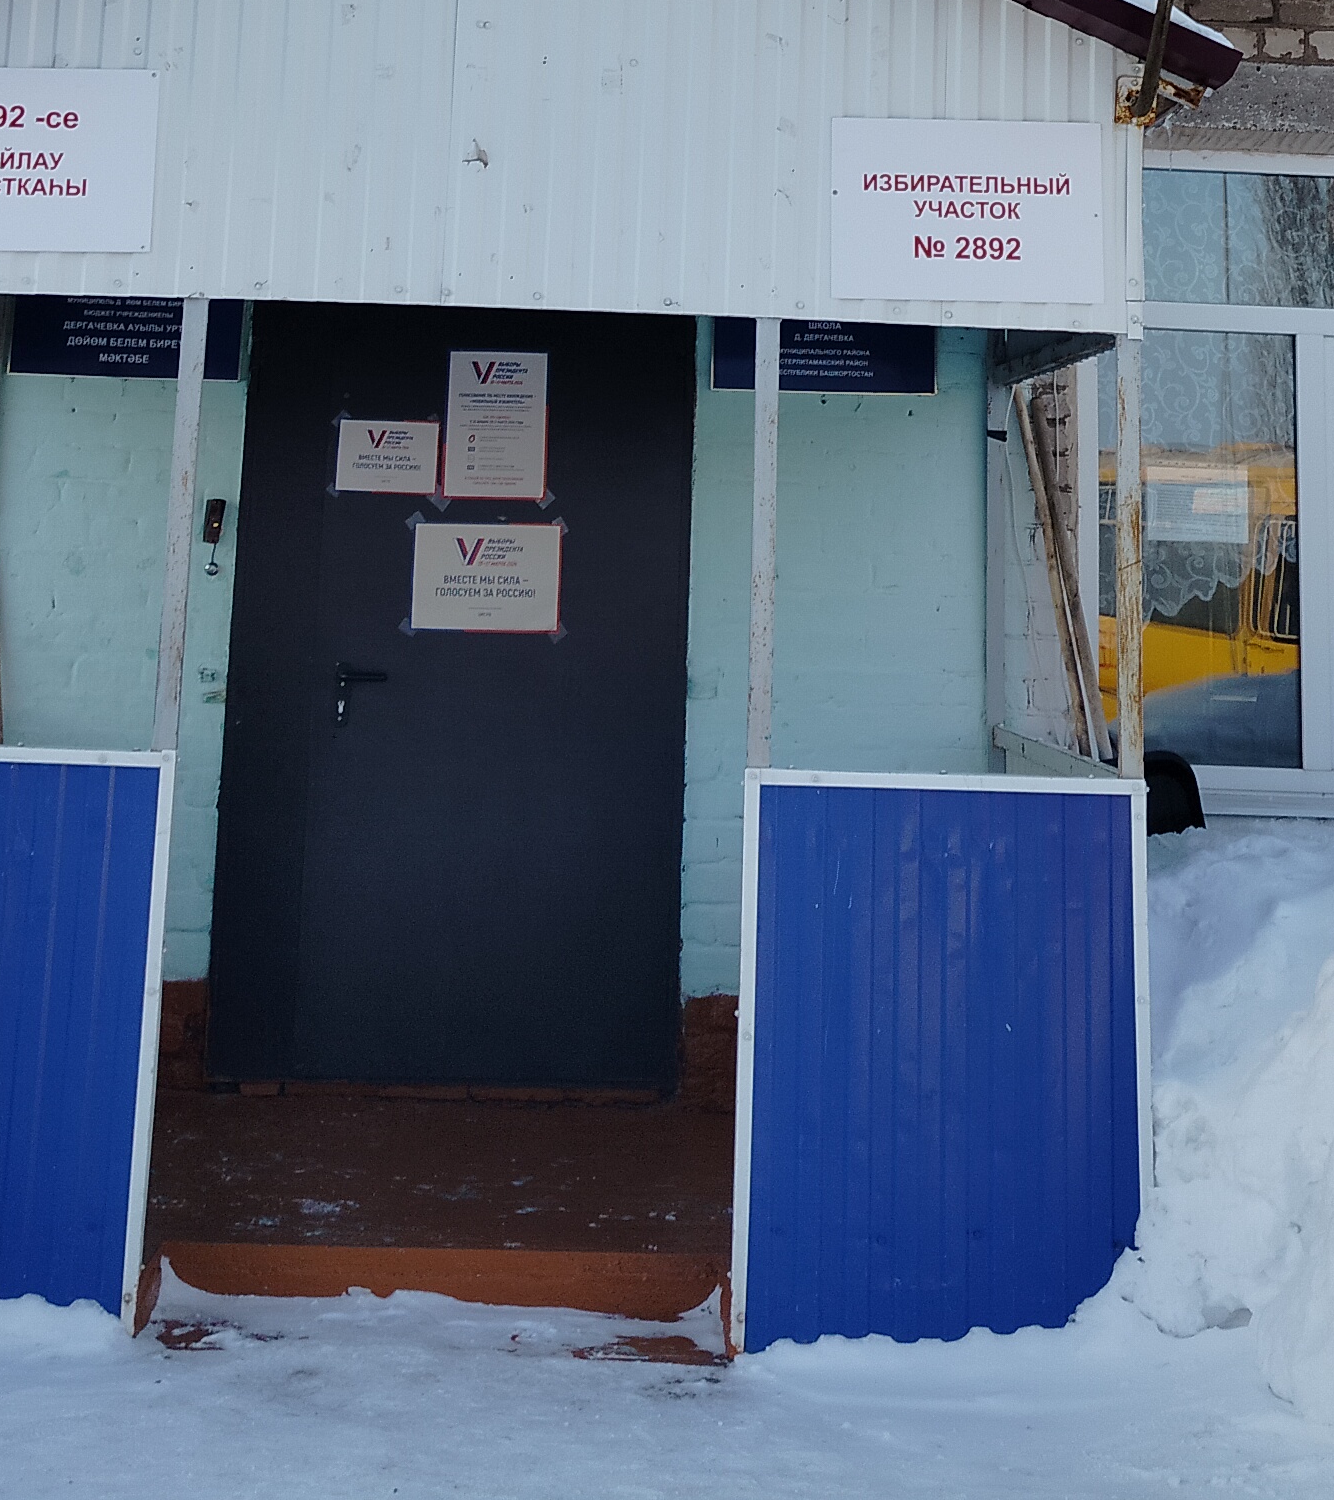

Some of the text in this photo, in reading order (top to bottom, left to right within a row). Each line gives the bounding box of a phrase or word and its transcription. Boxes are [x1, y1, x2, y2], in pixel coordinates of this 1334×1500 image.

[35, 108, 80, 130] -се
[863, 172, 1071, 196] ИЗБИРАТЕЛЬНЫЙ
[913, 199, 1021, 220] УЧАСТОК
[914, 235, 1022, 261] № 2892
[63, 320, 183, 333] ДЕРГАЧЕВКА АУЫЛЫ УРТ
[808, 321, 842, 331] ШКОЛА
[67, 336, 107, 347] ДӨЙӨМ
[110, 337, 147, 348] БЕЛЕМ
[803, 334, 854, 342] ДЕРГАЧЕВКА
[98, 352, 150, 364] МӘКТӘБЕ
[843, 349, 870, 357] РАЙОНА
[845, 359, 869, 367] РАЙОН
[779, 368, 874, 378] ЕСПУБЛИКИ БАШКОРТОСТАН
[443, 575, 478, 585] ВМЕСТЕ
[479, 576, 495, 585] МЫ
[497, 576, 521, 585] СИЛА
[435, 587, 536, 599] ГОЛОСУЕМ ЗА РОССИЮ!
